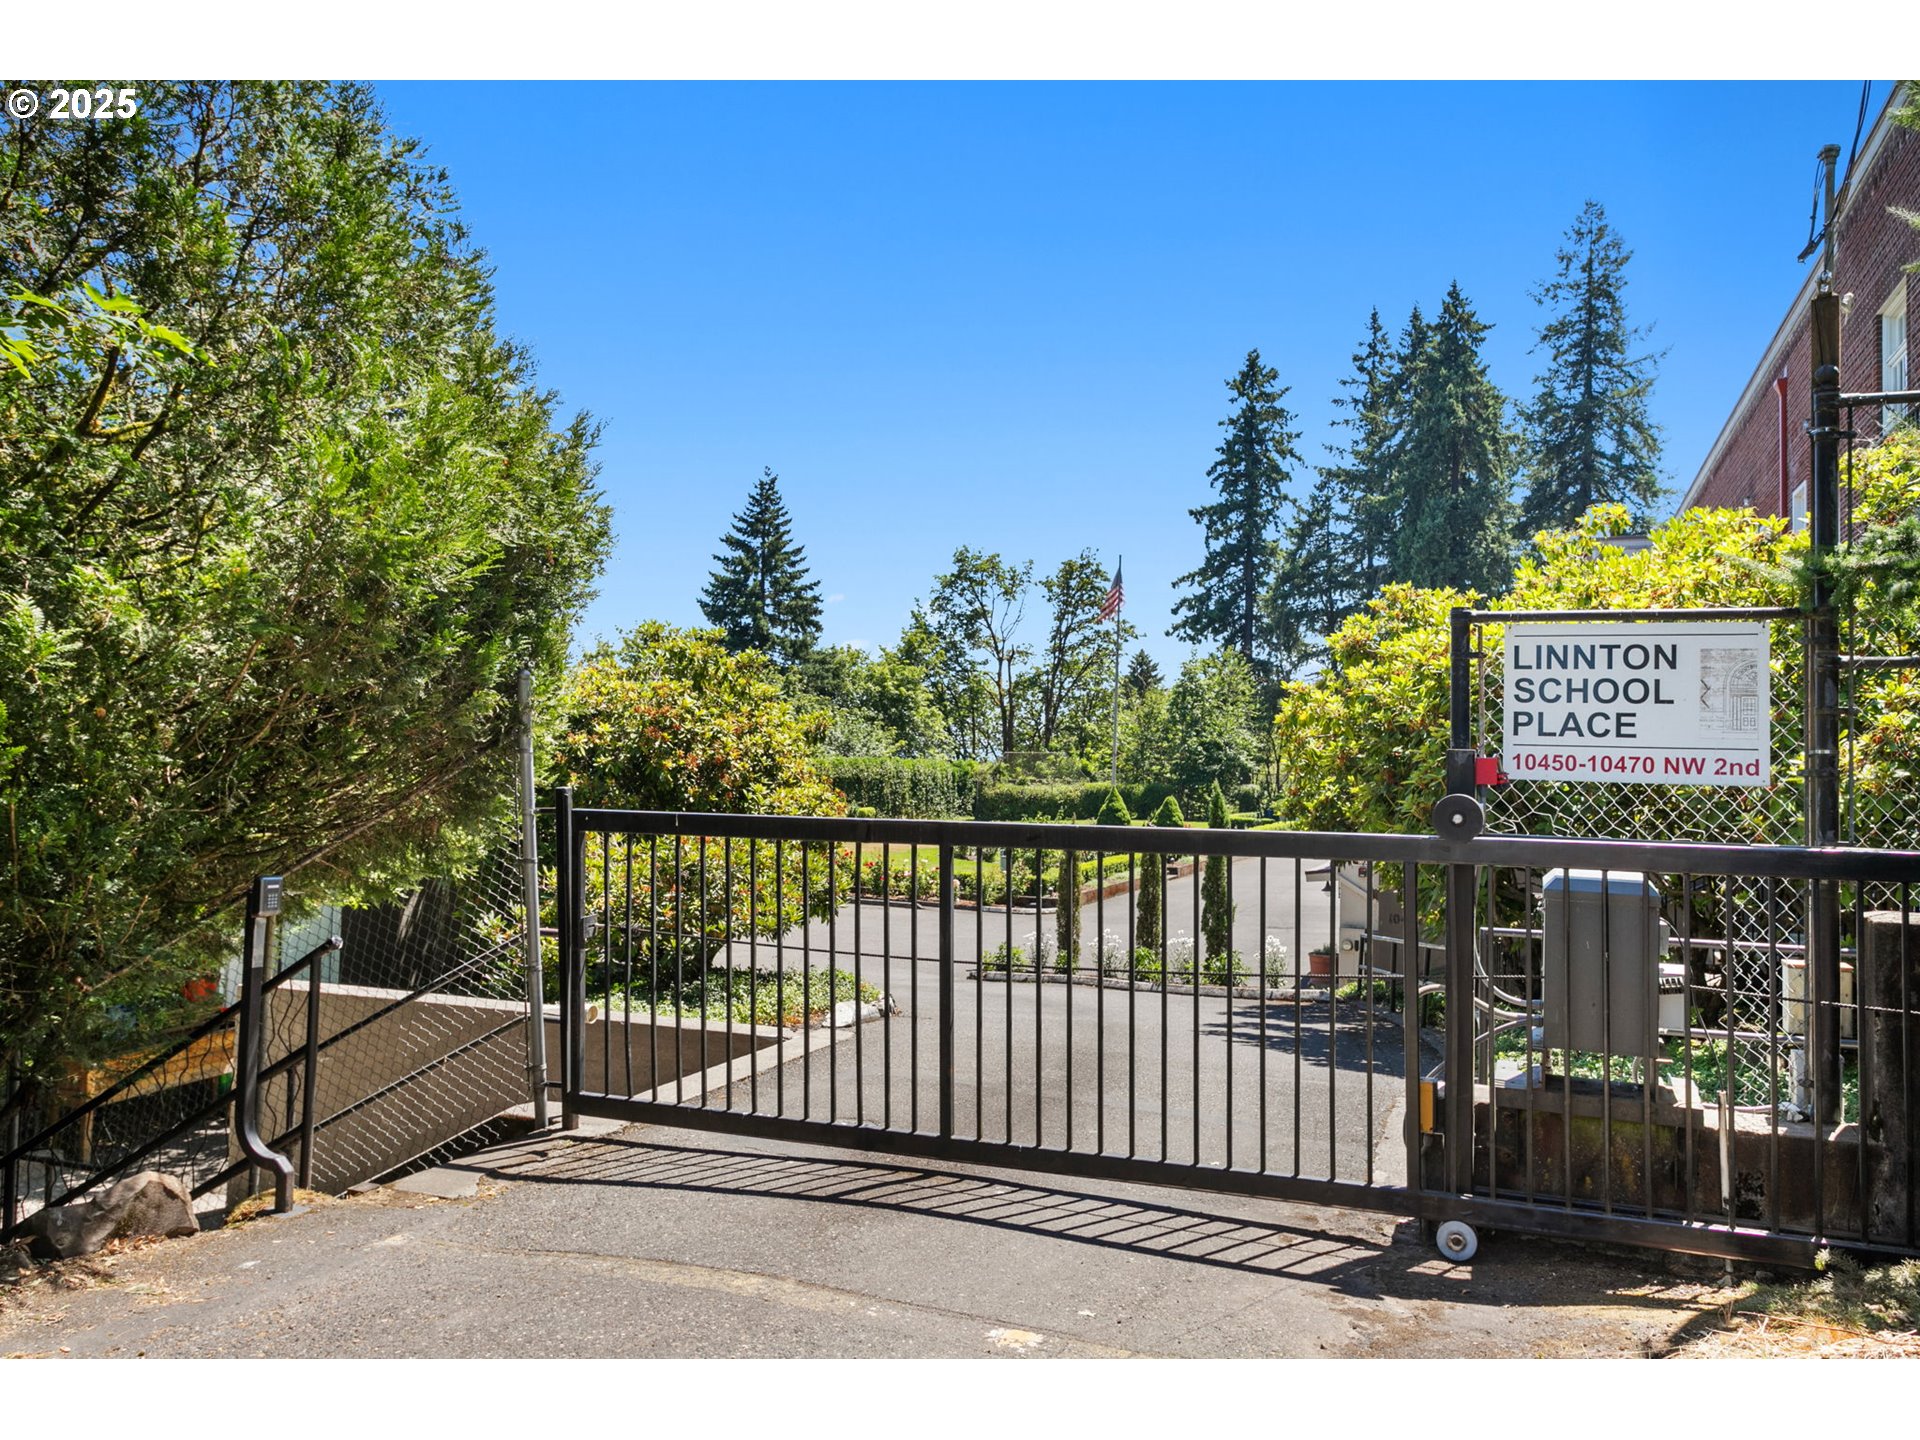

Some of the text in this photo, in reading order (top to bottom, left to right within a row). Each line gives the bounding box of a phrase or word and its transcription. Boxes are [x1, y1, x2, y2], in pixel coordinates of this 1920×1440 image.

[1513, 644, 1678, 670] LINNTON
[1513, 677, 1675, 705] SCHOOL
[1512, 711, 1637, 739] PLACE
[1512, 753, 1760, 777] 10450-10470 NW 2nd
